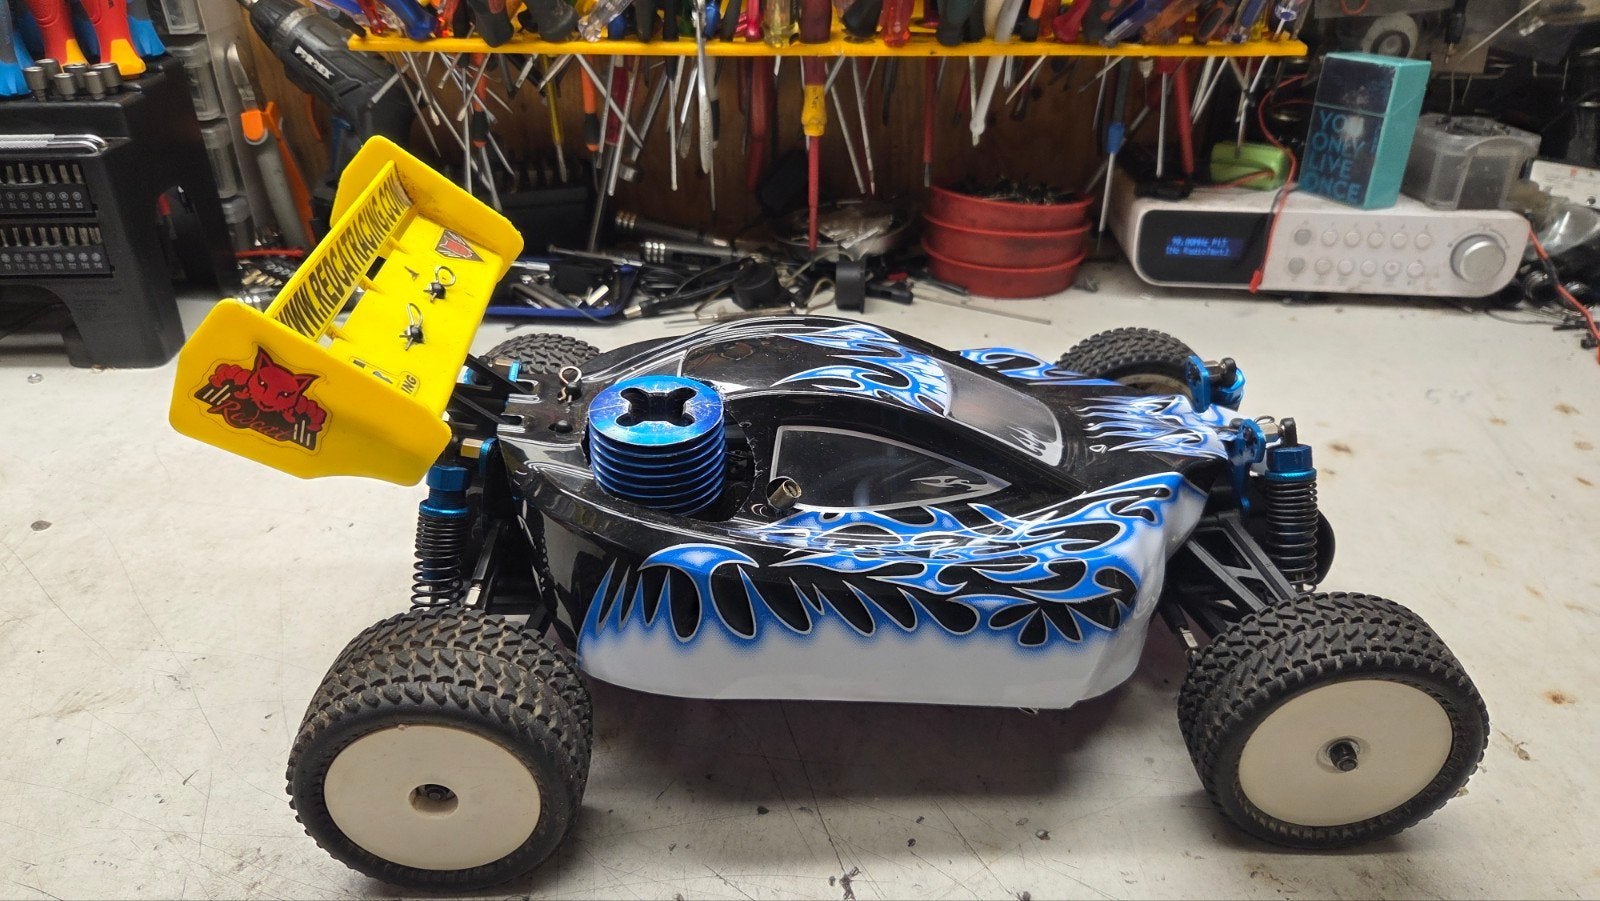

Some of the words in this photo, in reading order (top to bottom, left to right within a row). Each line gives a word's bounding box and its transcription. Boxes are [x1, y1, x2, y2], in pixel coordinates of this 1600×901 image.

[1319, 109, 1364, 138] YO
[1312, 130, 1366, 161] ONLY
[1307, 152, 1353, 179] LIVE
[1302, 169, 1362, 200] ONCE
